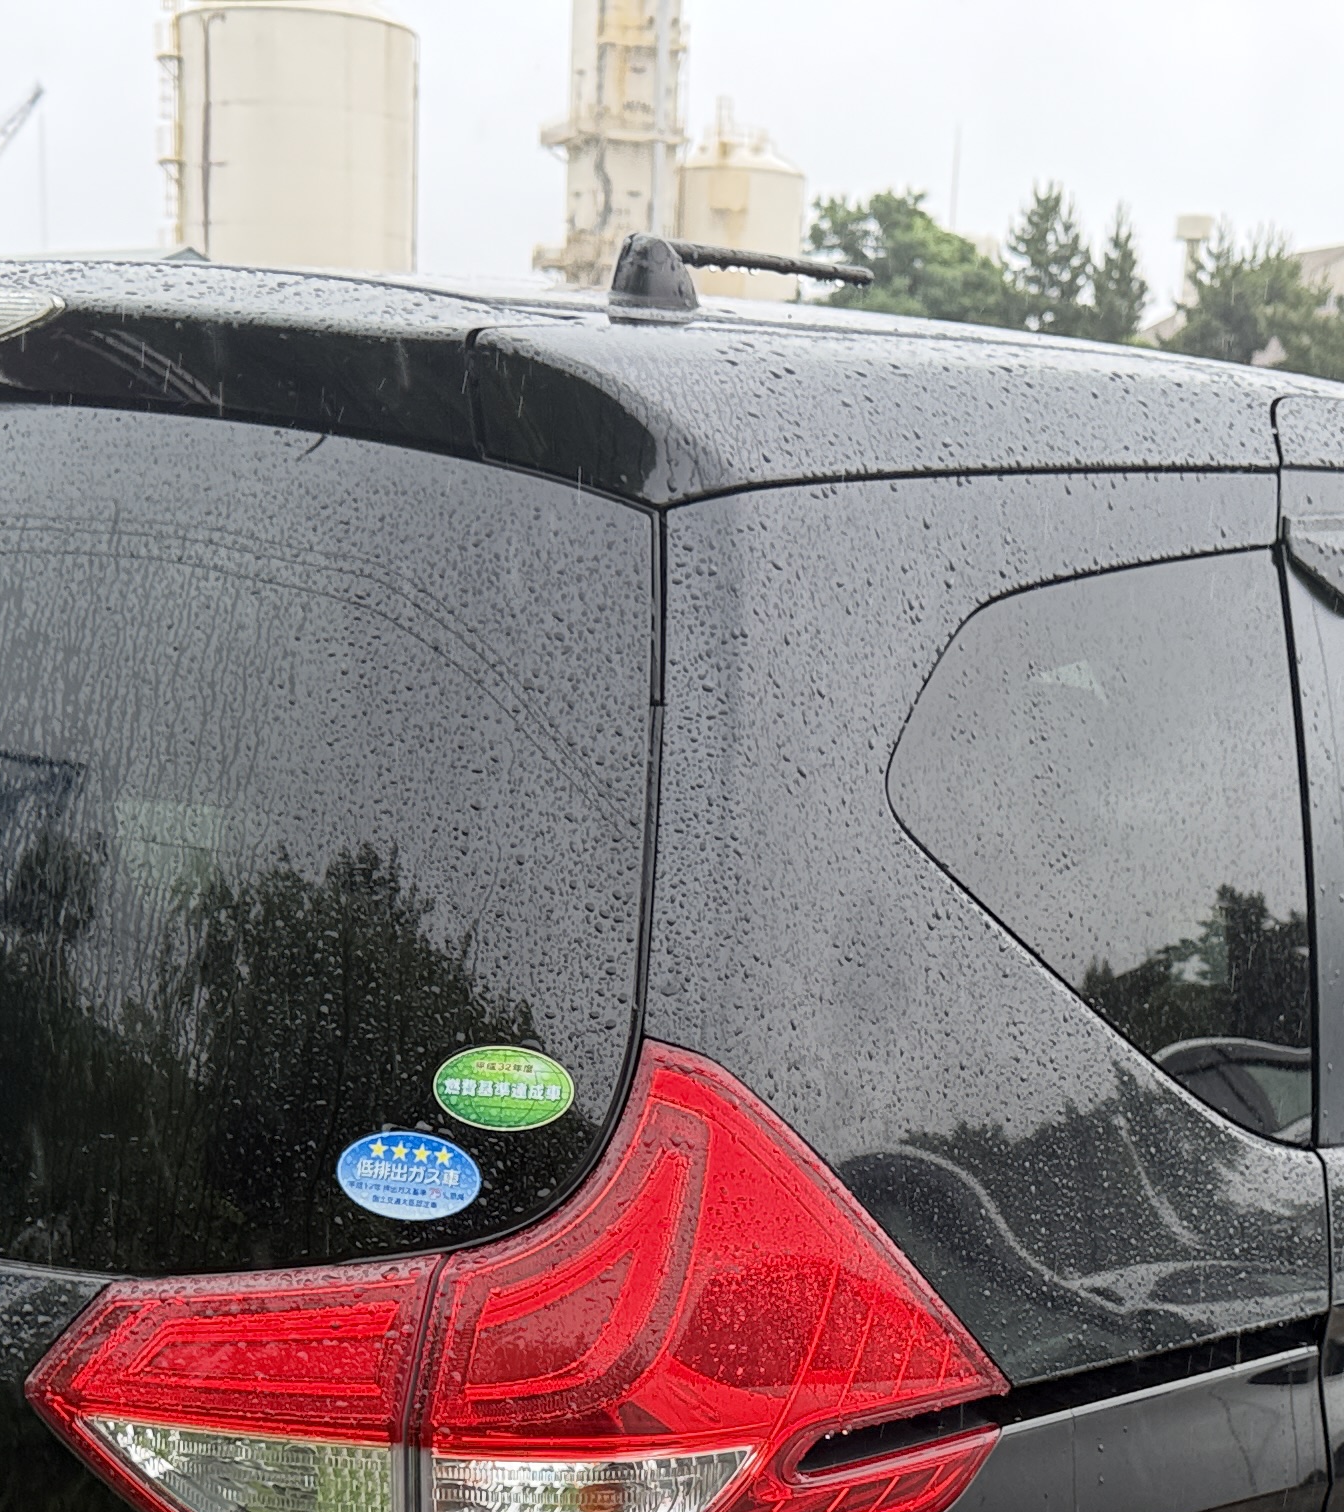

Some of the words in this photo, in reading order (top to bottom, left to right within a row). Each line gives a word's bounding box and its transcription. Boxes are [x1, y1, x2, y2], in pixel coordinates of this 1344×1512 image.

[444, 1078, 562, 1101] 燃費基準達成車
[357, 1159, 461, 1187] 低排出ガス車
